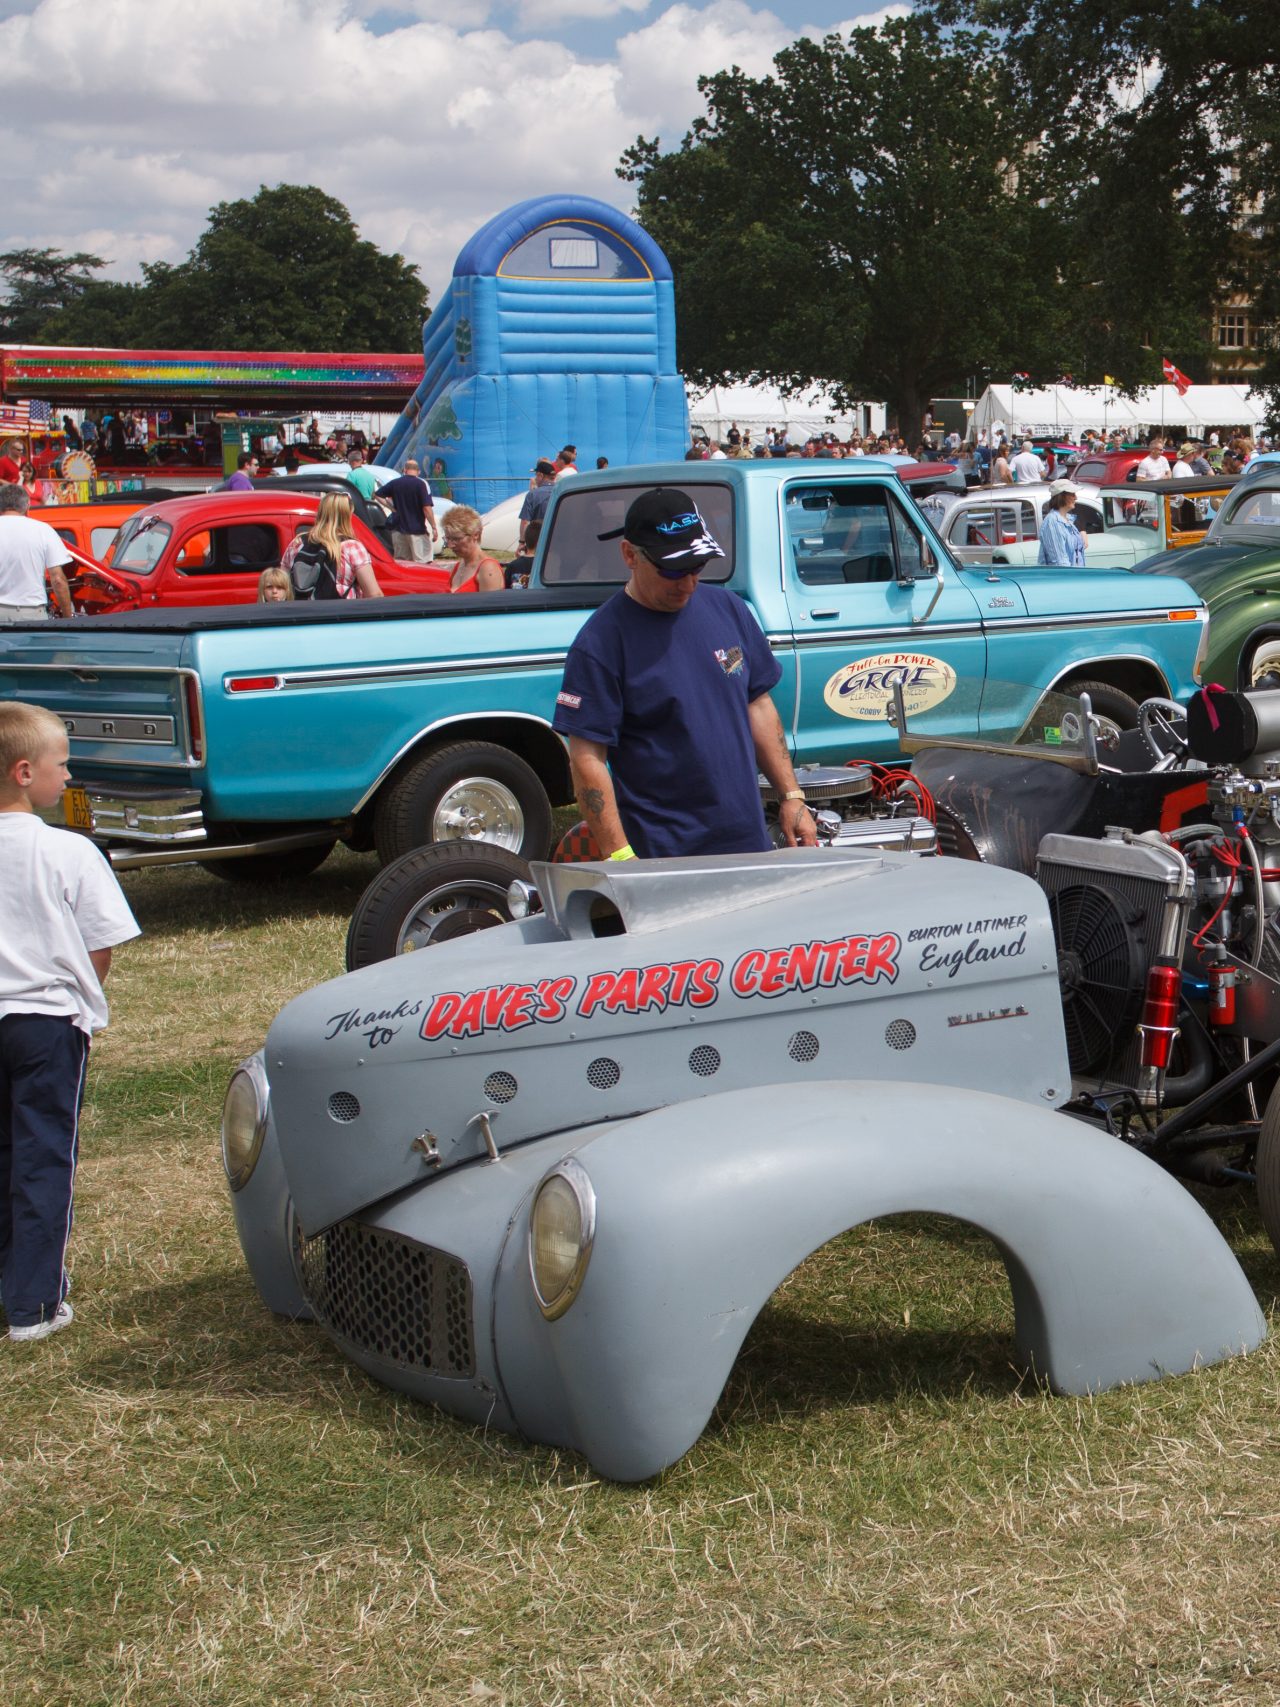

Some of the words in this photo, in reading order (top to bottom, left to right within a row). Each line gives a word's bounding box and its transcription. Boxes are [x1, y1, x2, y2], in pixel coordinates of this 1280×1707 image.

[894, 654, 937, 668] POWER
[839, 665, 941, 695] GROVE
[64, 720, 157, 736] ORD
[907, 922, 961, 943] BURTON
[966, 914, 1028, 934] LATIMER
[919, 931, 1027, 978] England
[419, 975, 577, 1042] DAVE'S
[575, 957, 724, 1019] PARTS
[729, 931, 902, 999] CENTER
[325, 999, 423, 1040] Thanks
[363, 1025, 403, 1049] to
